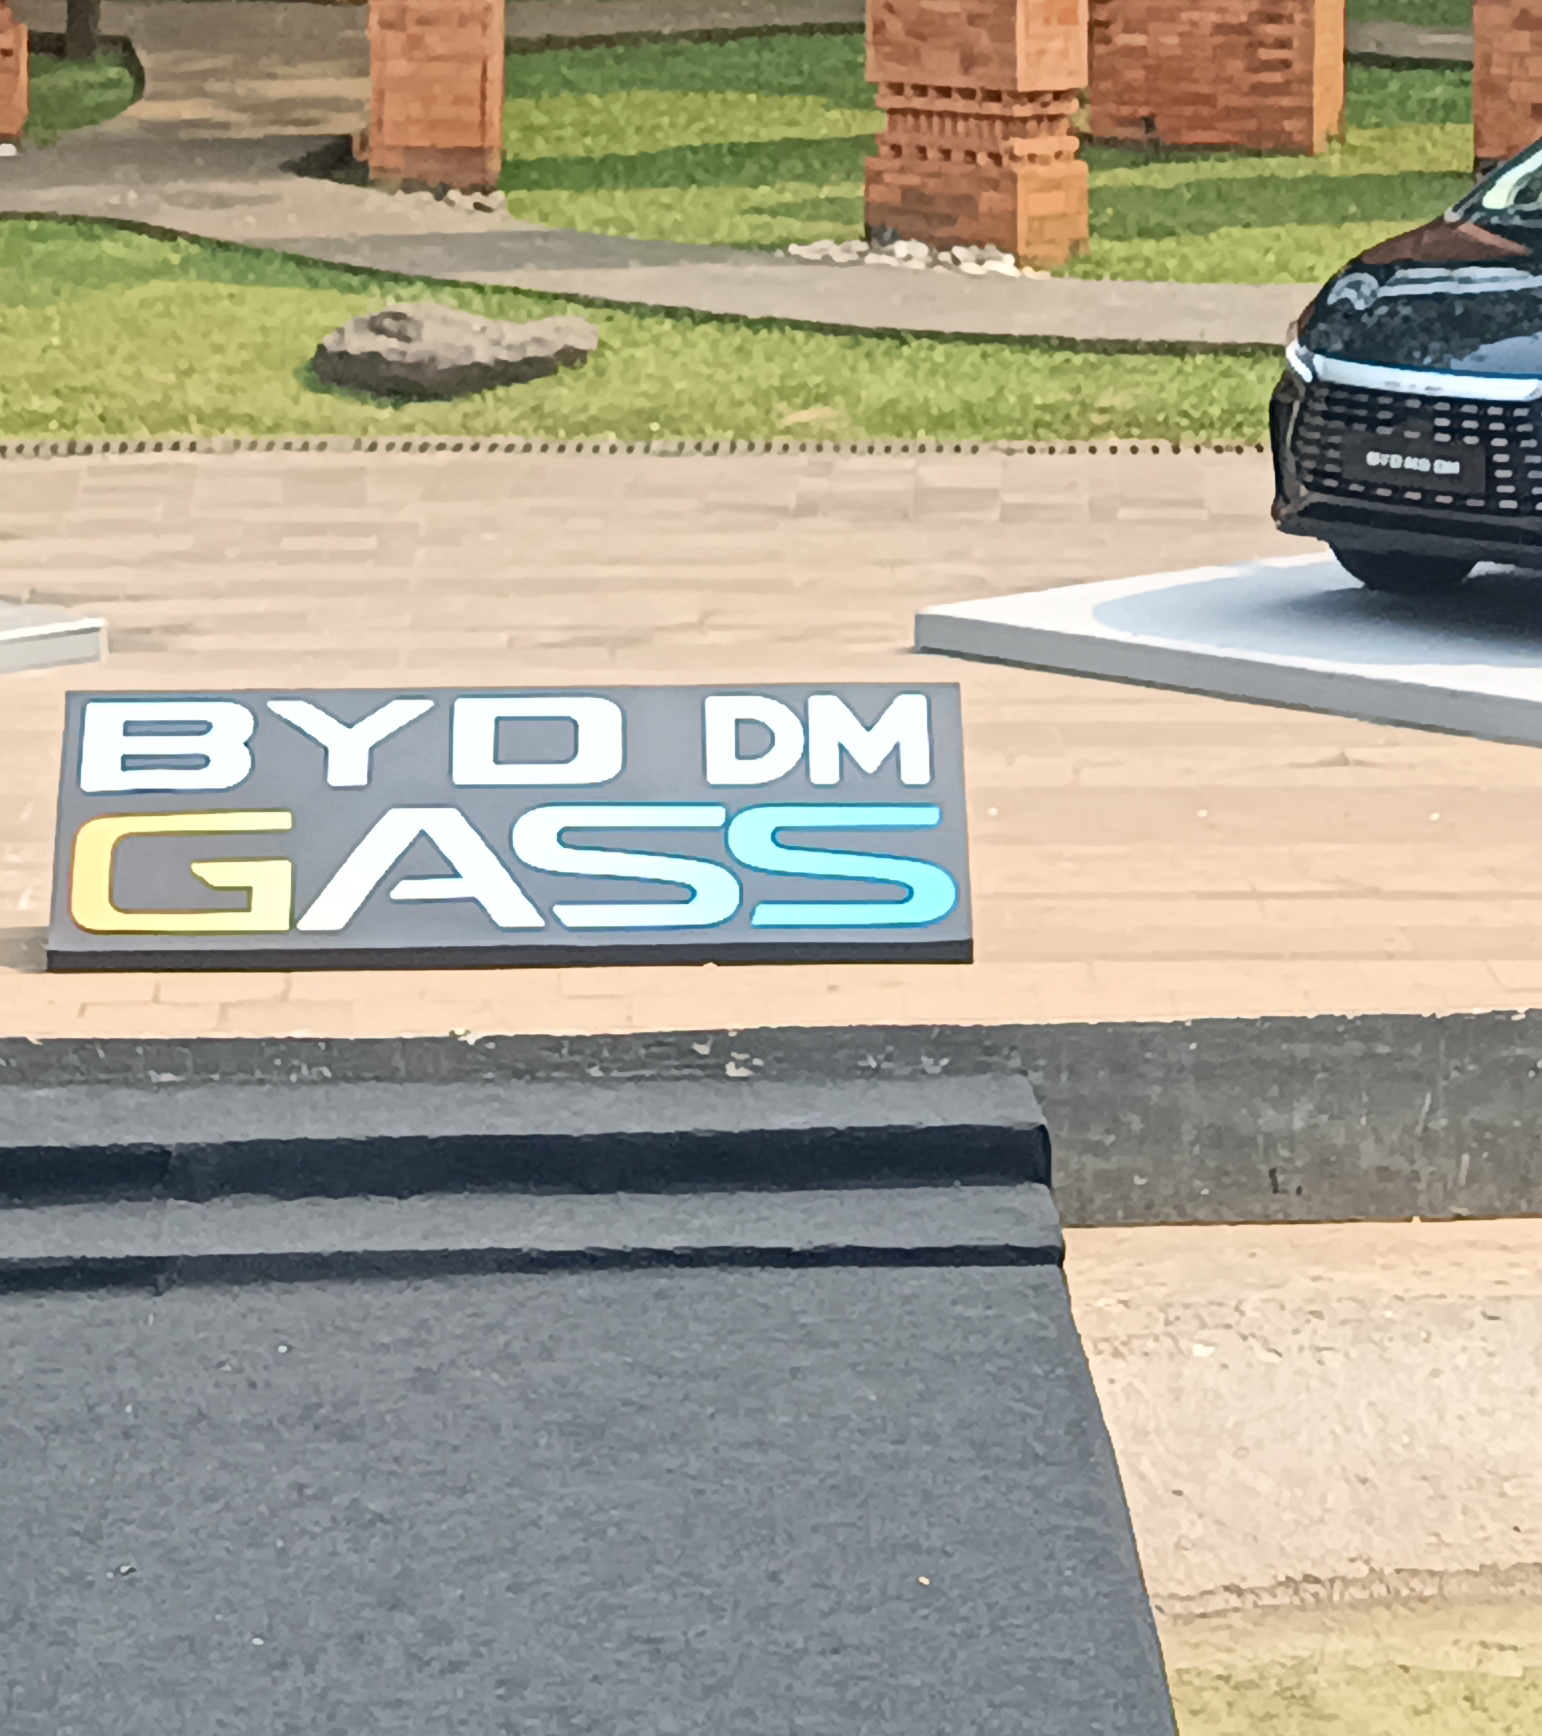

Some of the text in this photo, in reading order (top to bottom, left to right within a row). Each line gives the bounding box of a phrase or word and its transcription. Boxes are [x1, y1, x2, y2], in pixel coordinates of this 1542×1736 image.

[80, 692, 932, 793] BYD DM
[70, 802, 959, 934] GASS
